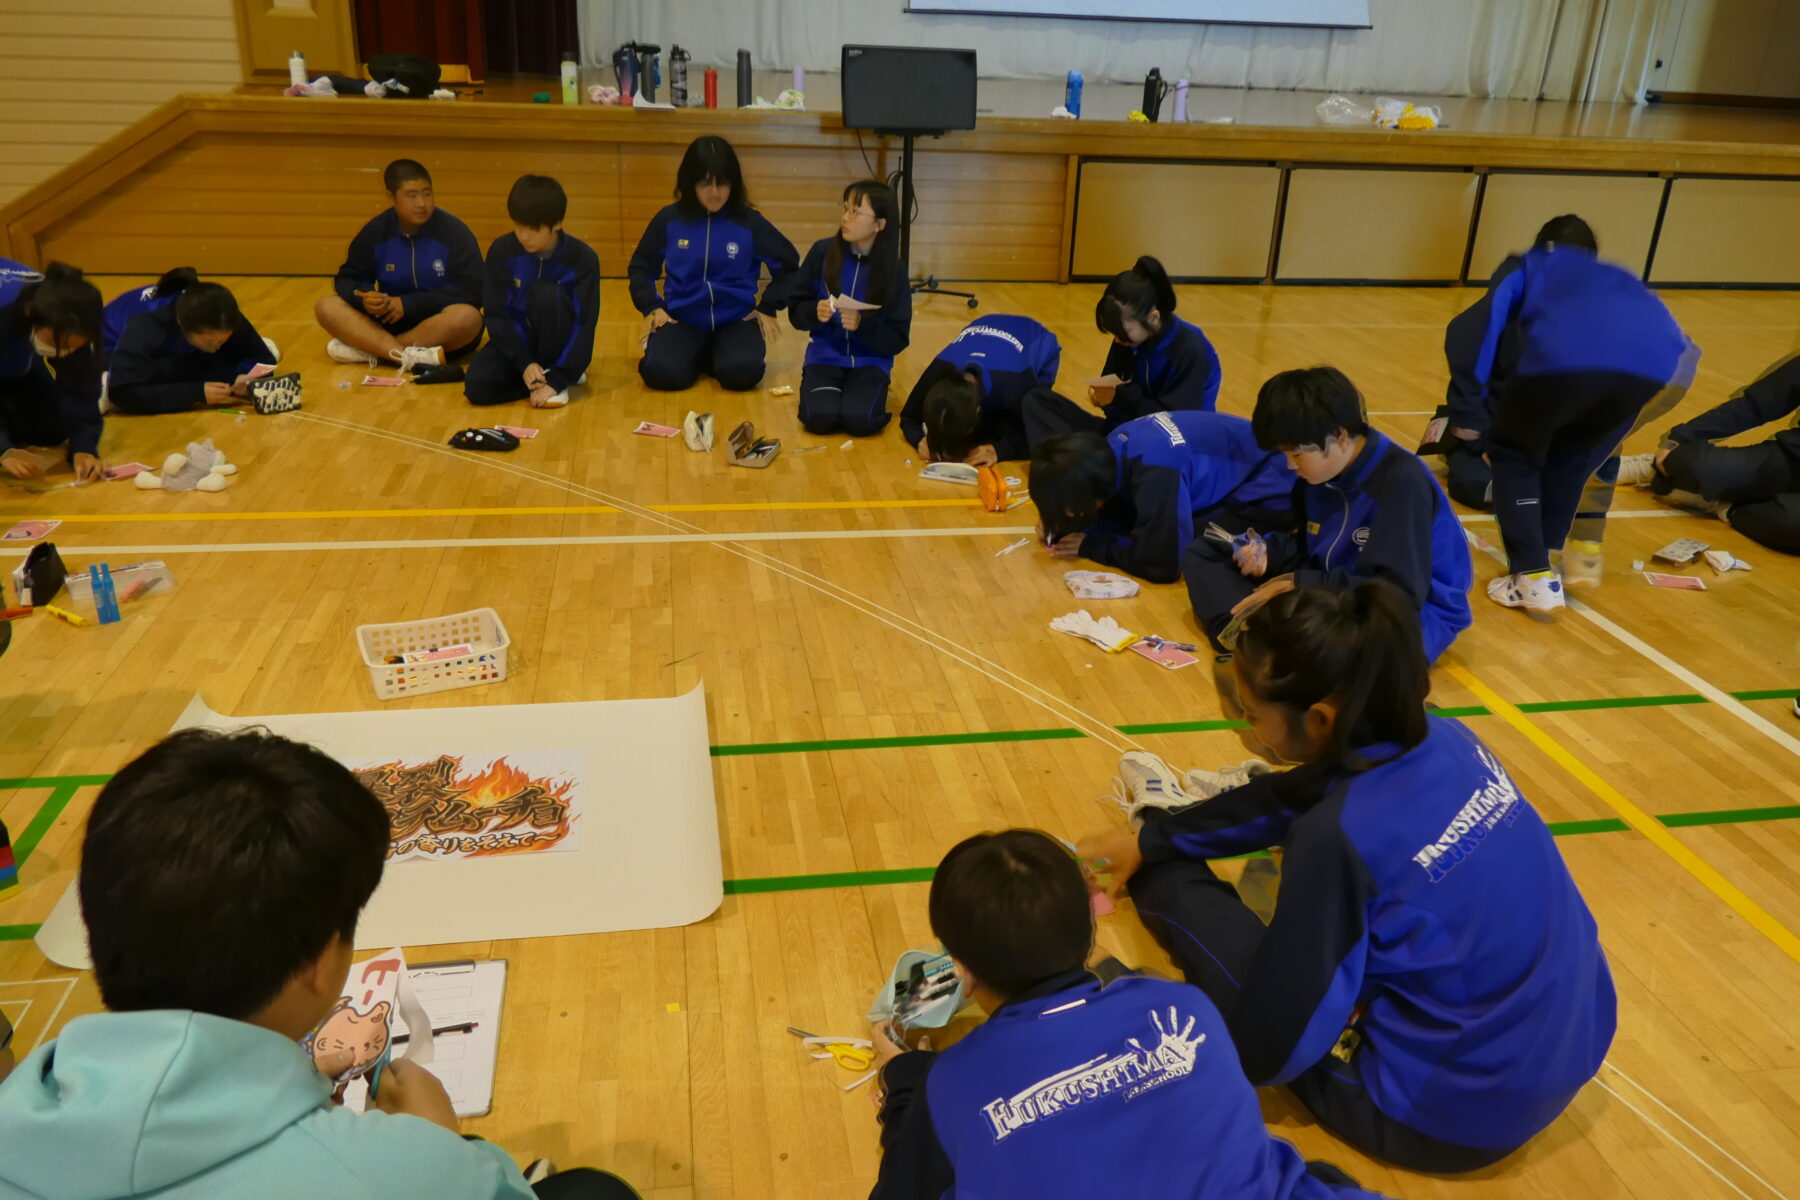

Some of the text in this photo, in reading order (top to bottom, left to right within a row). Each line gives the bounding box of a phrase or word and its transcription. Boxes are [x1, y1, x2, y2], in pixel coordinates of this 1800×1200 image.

[388, 785, 568, 842] ラムーチョ
[980, 1045, 1187, 1143] FUKUSHIMA
